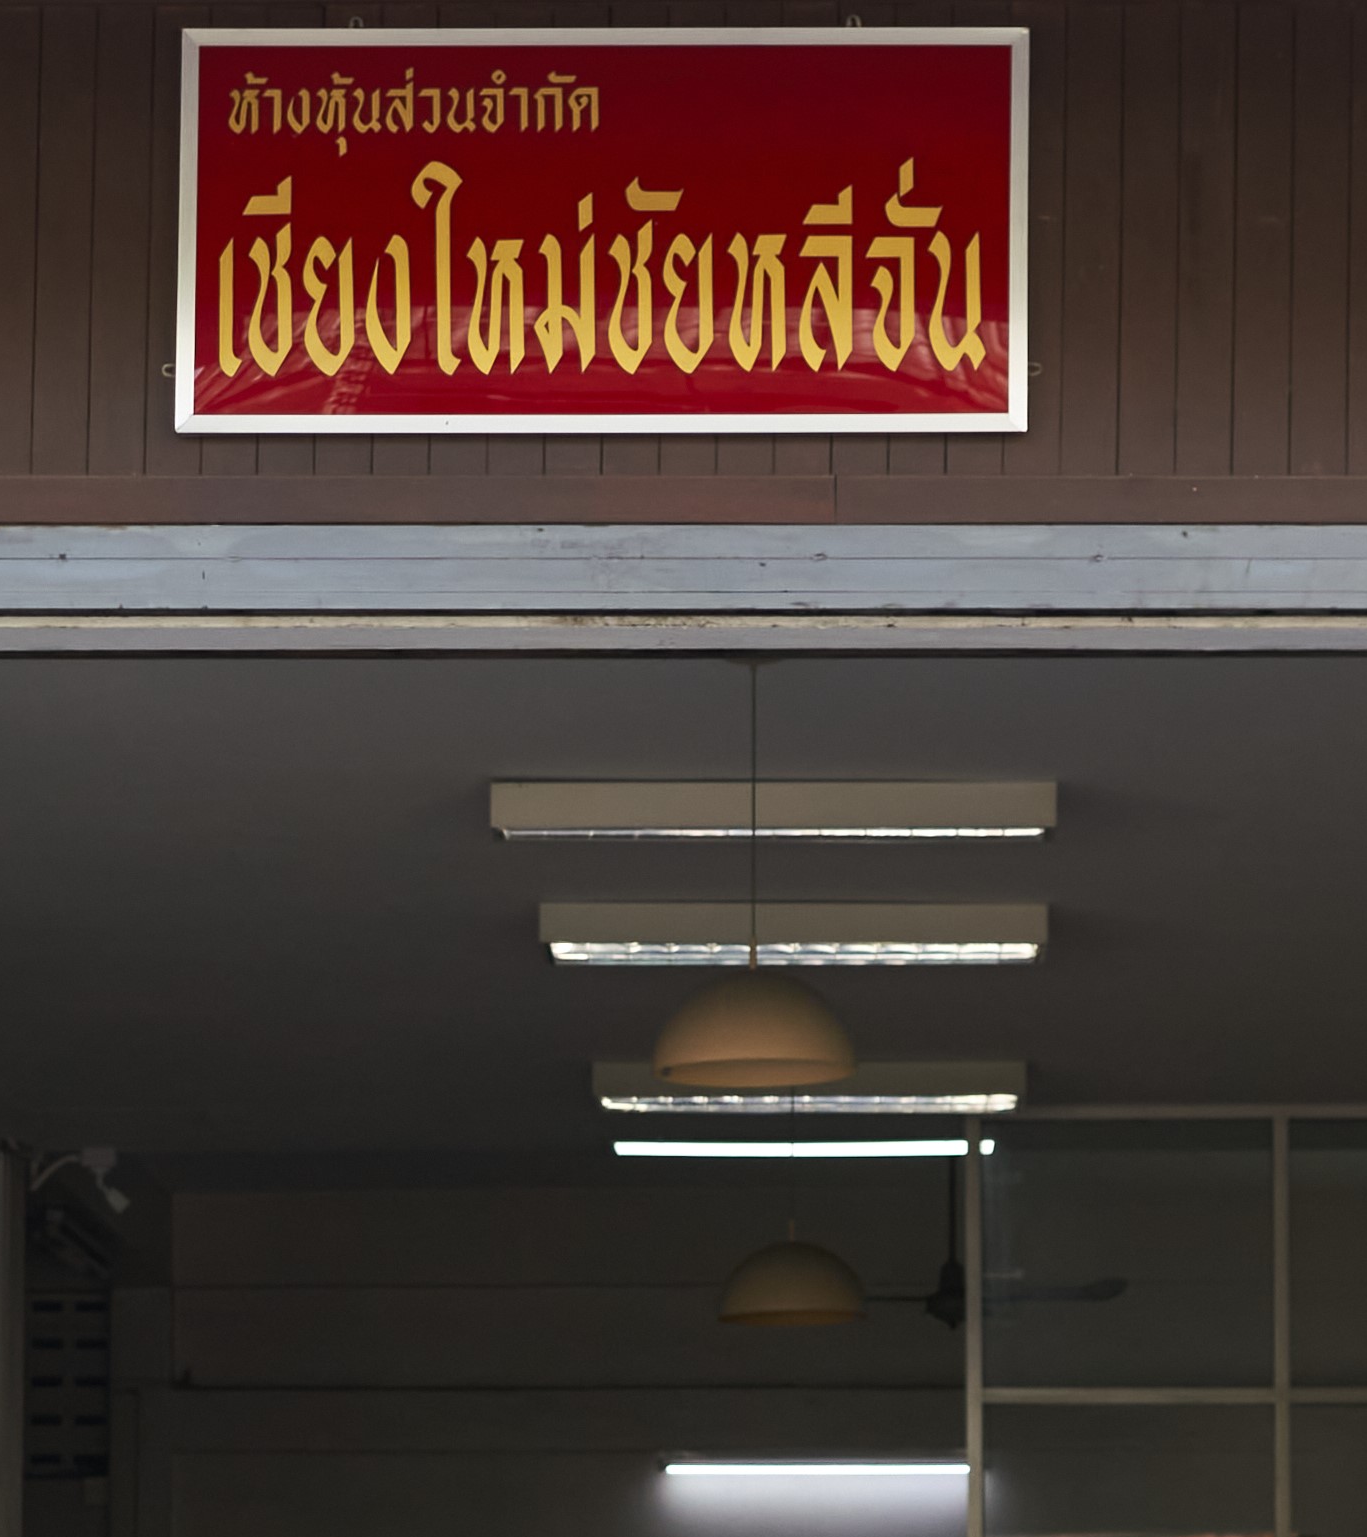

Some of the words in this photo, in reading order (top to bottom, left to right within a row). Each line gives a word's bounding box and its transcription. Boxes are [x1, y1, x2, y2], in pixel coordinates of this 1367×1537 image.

[228, 68, 600, 156] ห้างหุ้นส่วนจำกัด
[218, 157, 988, 378] เชียงใหม่ชัยหลีจั่น
